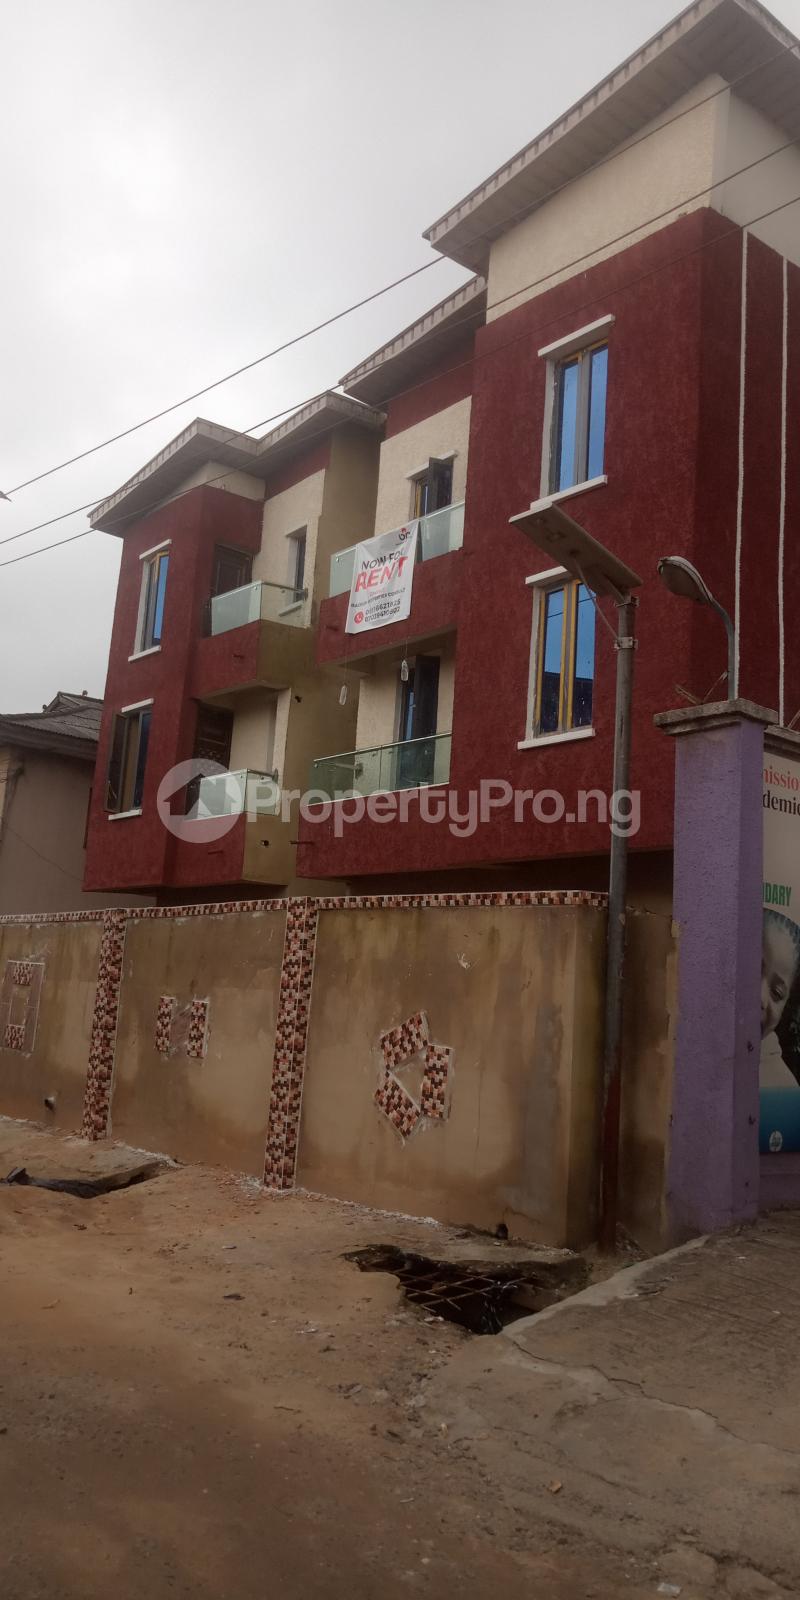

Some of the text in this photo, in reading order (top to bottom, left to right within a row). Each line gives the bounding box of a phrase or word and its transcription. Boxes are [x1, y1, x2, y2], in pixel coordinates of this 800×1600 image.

[355, 556, 408, 592] RENT
[361, 555, 387, 570] NOW
[763, 765, 800, 792] issio
